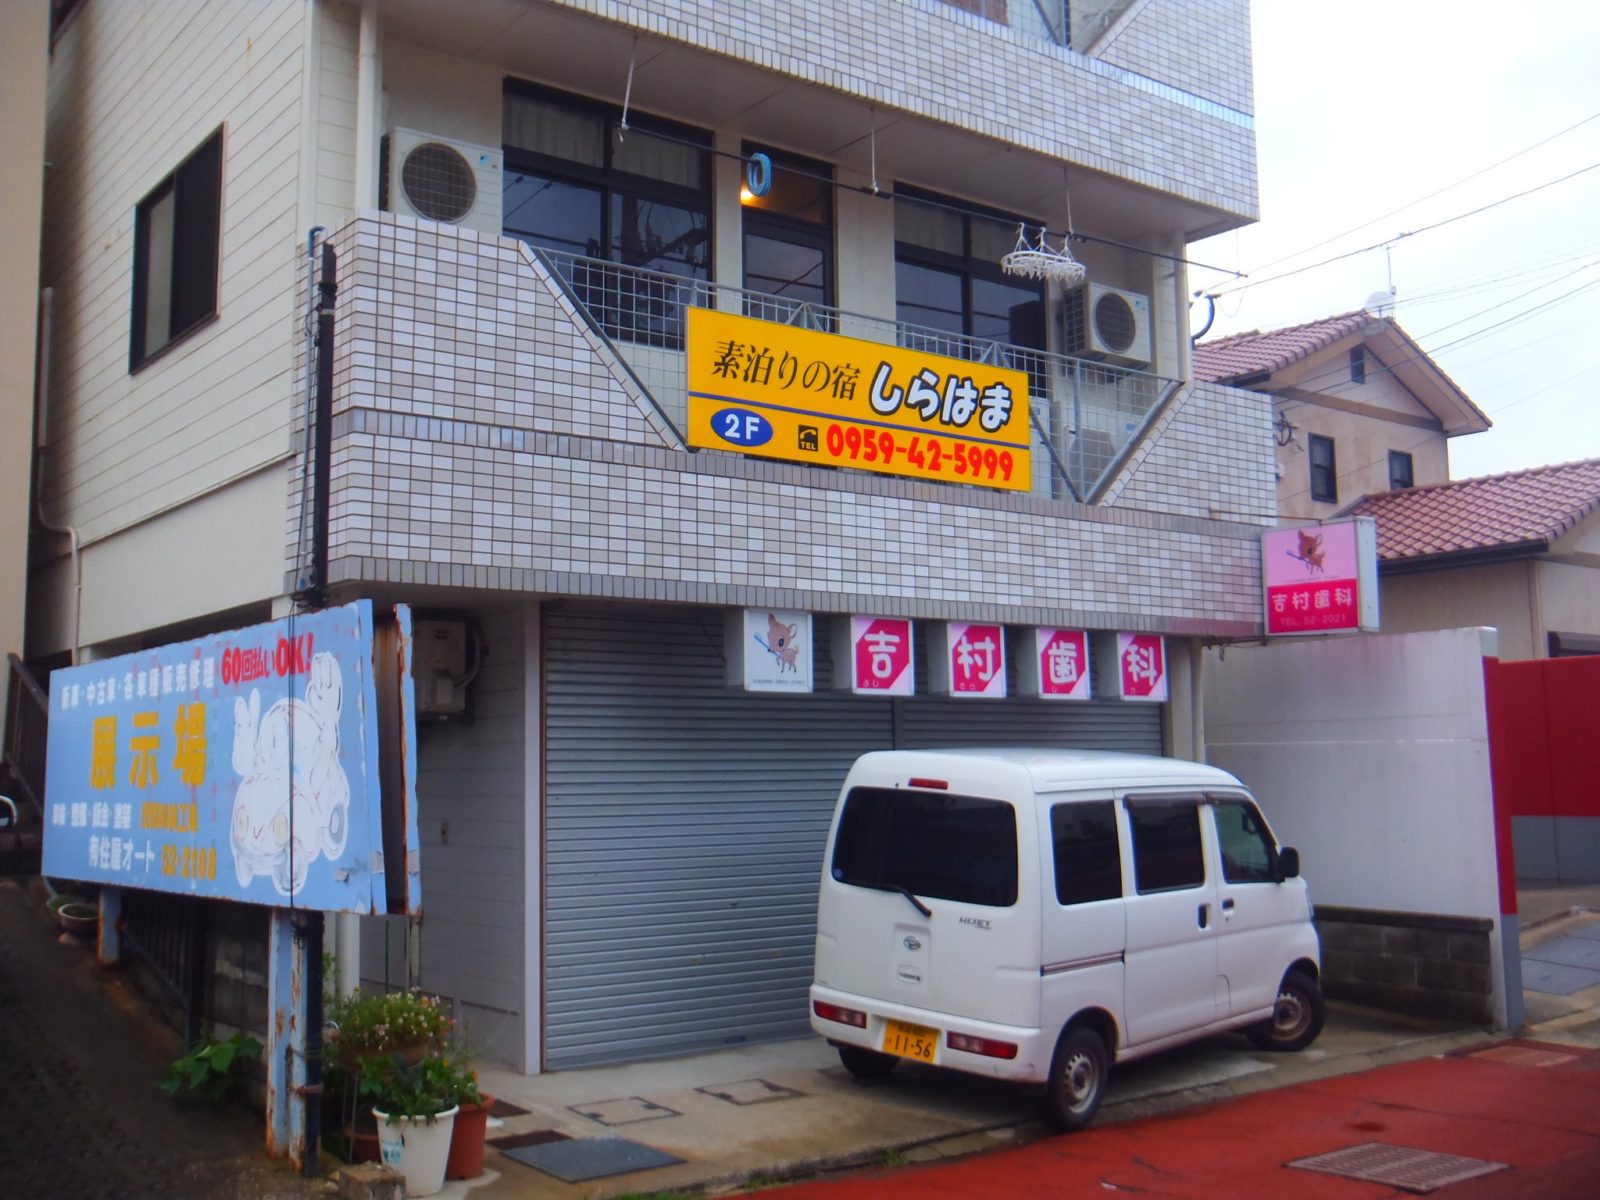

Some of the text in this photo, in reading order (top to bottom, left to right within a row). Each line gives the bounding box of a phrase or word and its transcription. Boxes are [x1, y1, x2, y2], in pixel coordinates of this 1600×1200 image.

[712, 340, 1013, 433] 素泊りの宿 しらはま
[725, 413, 760, 440] 2F
[800, 423, 1014, 482] TEL 0959-42-5999
[1272, 587, 1352, 612] 吉村歯科
[89, 702, 208, 790] 展示場
